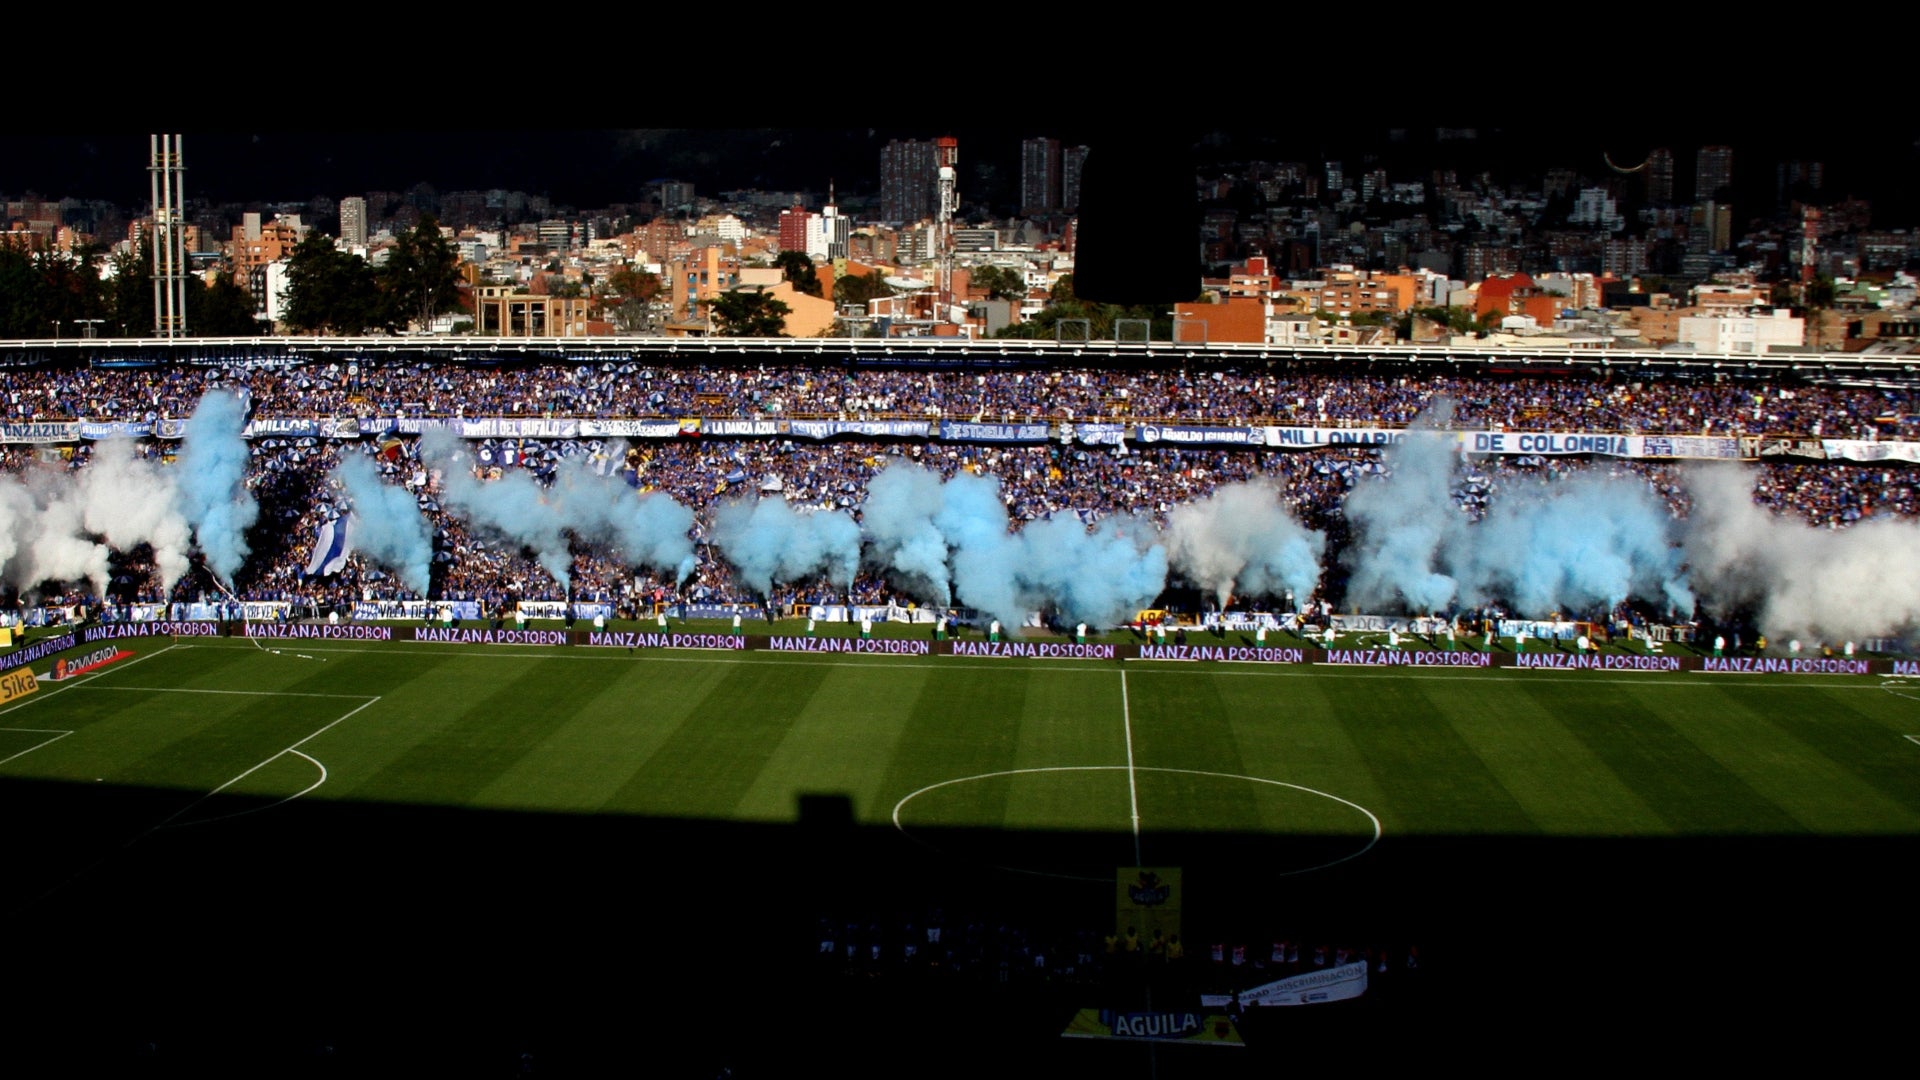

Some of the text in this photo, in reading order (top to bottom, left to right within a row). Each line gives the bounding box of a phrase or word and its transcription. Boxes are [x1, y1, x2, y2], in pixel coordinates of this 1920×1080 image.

[255, 419, 311, 433] MILLOS
[500, 420, 519, 436] DEL
[521, 420, 560, 436] BUFALO
[712, 422, 777, 434] LA DANZA AZUL
[957, 424, 1048, 440] ESTRELLA AZUL
[1161, 430, 1203, 441] ARNOLDO
[1475, 433, 1504, 451] DE
[1519, 434, 1629, 454] COLOMBIA
[85, 621, 217, 643] MANZANA POSTOBON
[245, 623, 391, 640] MANZANA POSTOBON
[415, 627, 566, 645] MANZANA POSTOBON
[590, 632, 745, 649] MANZANA POSTOBON
[770, 636, 929, 654] MANZANA POSTOBON
[0, 634, 76, 670] MANZANA POSTOBON
[953, 641, 1115, 658] MANZANA POSTOBON
[1140, 645, 1303, 662] MANZANA POSTOBON
[1327, 649, 1491, 666] MANZANA POSTOBON
[67, 645, 119, 674] DAVIVIENDA
[1516, 653, 1680, 670] MANZANA POSTOBON
[1703, 656, 1869, 674] MANZANA POSTOBON
[1, 671, 37, 699] Sika
[1116, 1012, 1197, 1036] AGUILA
